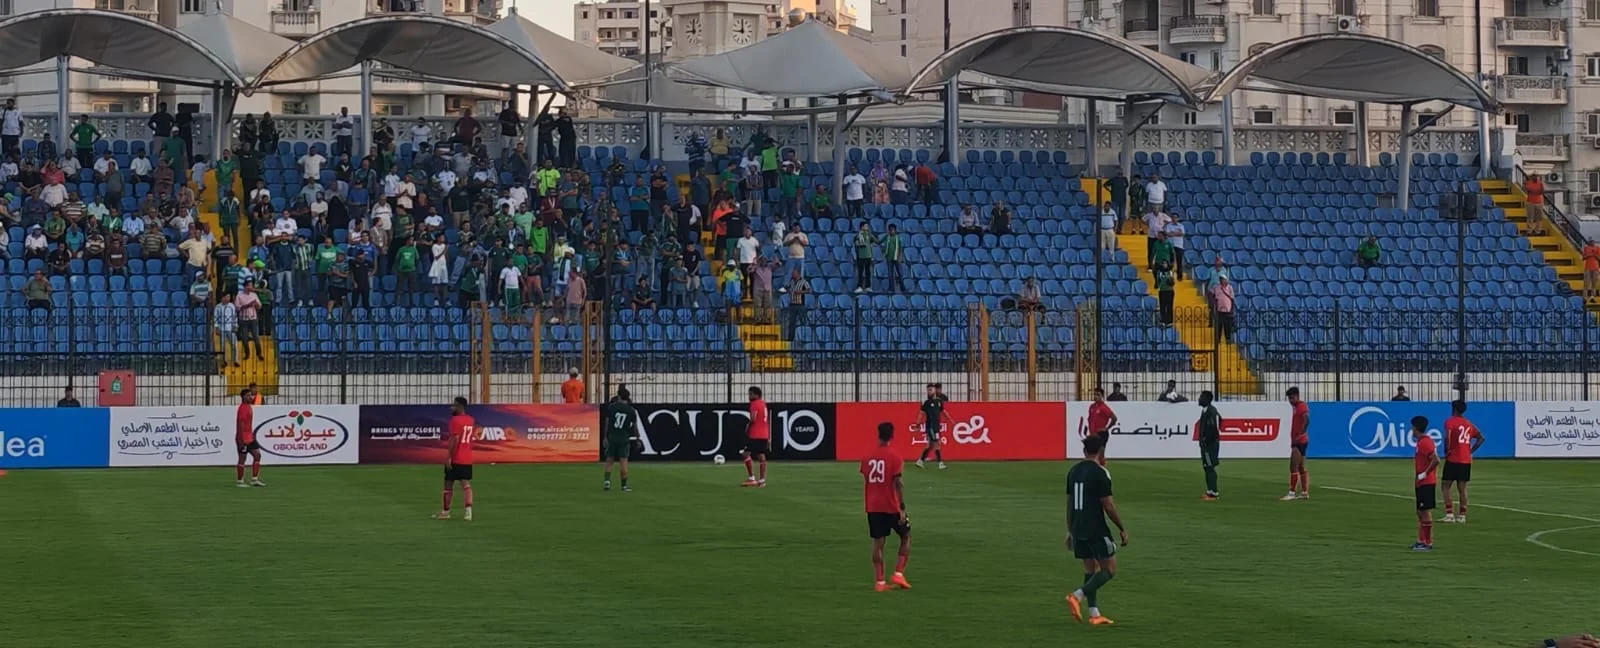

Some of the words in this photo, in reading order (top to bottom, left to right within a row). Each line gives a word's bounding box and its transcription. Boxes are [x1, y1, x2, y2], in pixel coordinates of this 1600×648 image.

[614, 412, 627, 429] 37
[461, 425, 473, 444] 17
[777, 409, 825, 452] 10
[1110, 422, 1189, 440] للرياضة
[1458, 425, 1471, 444] 24
[0, 430, 45, 457] ea
[272, 442, 329, 451] OBOURLAND
[868, 459, 885, 483] 29
[1074, 482, 1084, 510] 11
